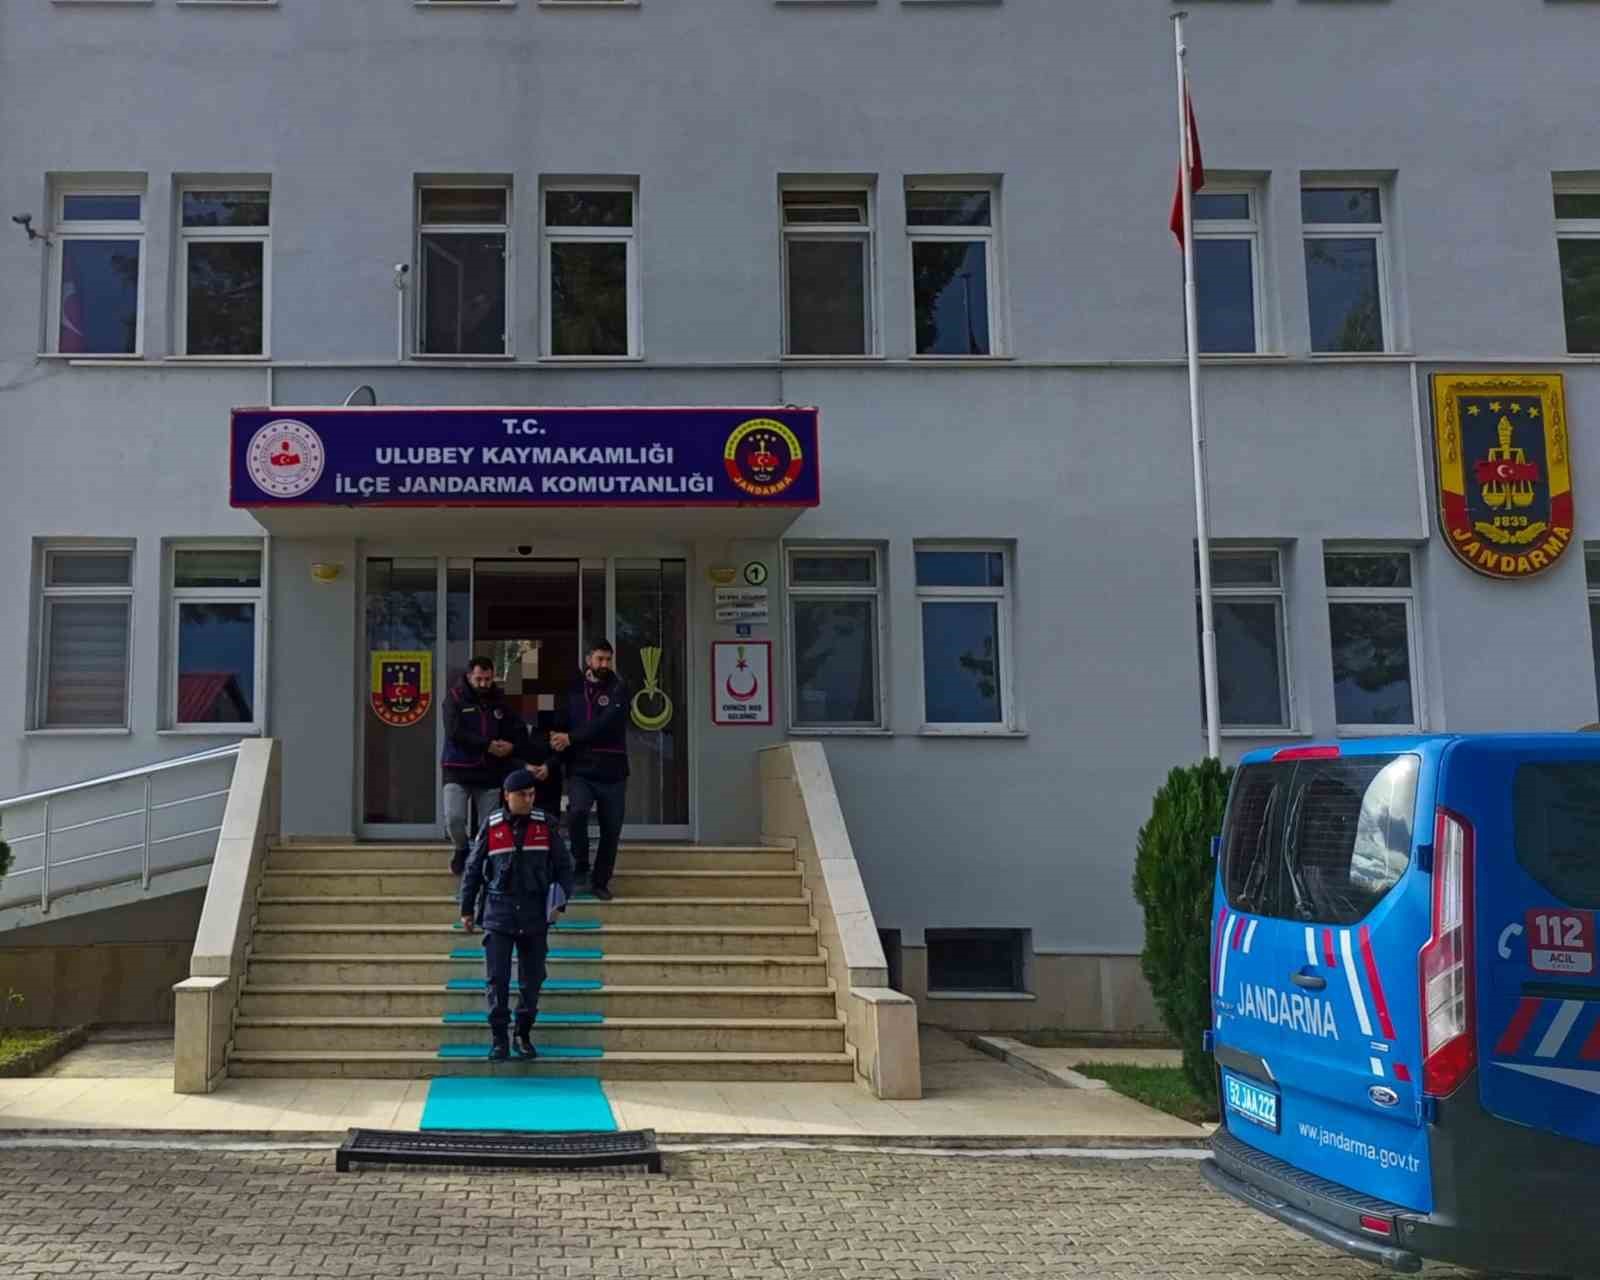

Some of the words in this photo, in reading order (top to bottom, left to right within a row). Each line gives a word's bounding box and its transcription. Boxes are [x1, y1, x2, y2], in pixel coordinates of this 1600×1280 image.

[502, 418, 547, 435] T.C.
[375, 447, 475, 465] ULUBEY
[482, 443, 674, 465] KAYMAKAMLIĞI
[335, 473, 391, 497] İLÇE
[398, 476, 534, 493] JANDARMA
[542, 472, 714, 493] KOMUTANLIĞI
[1453, 525, 1571, 573] JANDARMA
[751, 567, 760, 581] 1
[1535, 914, 1584, 948] 112
[1236, 981, 1339, 1040] JANDARMA
